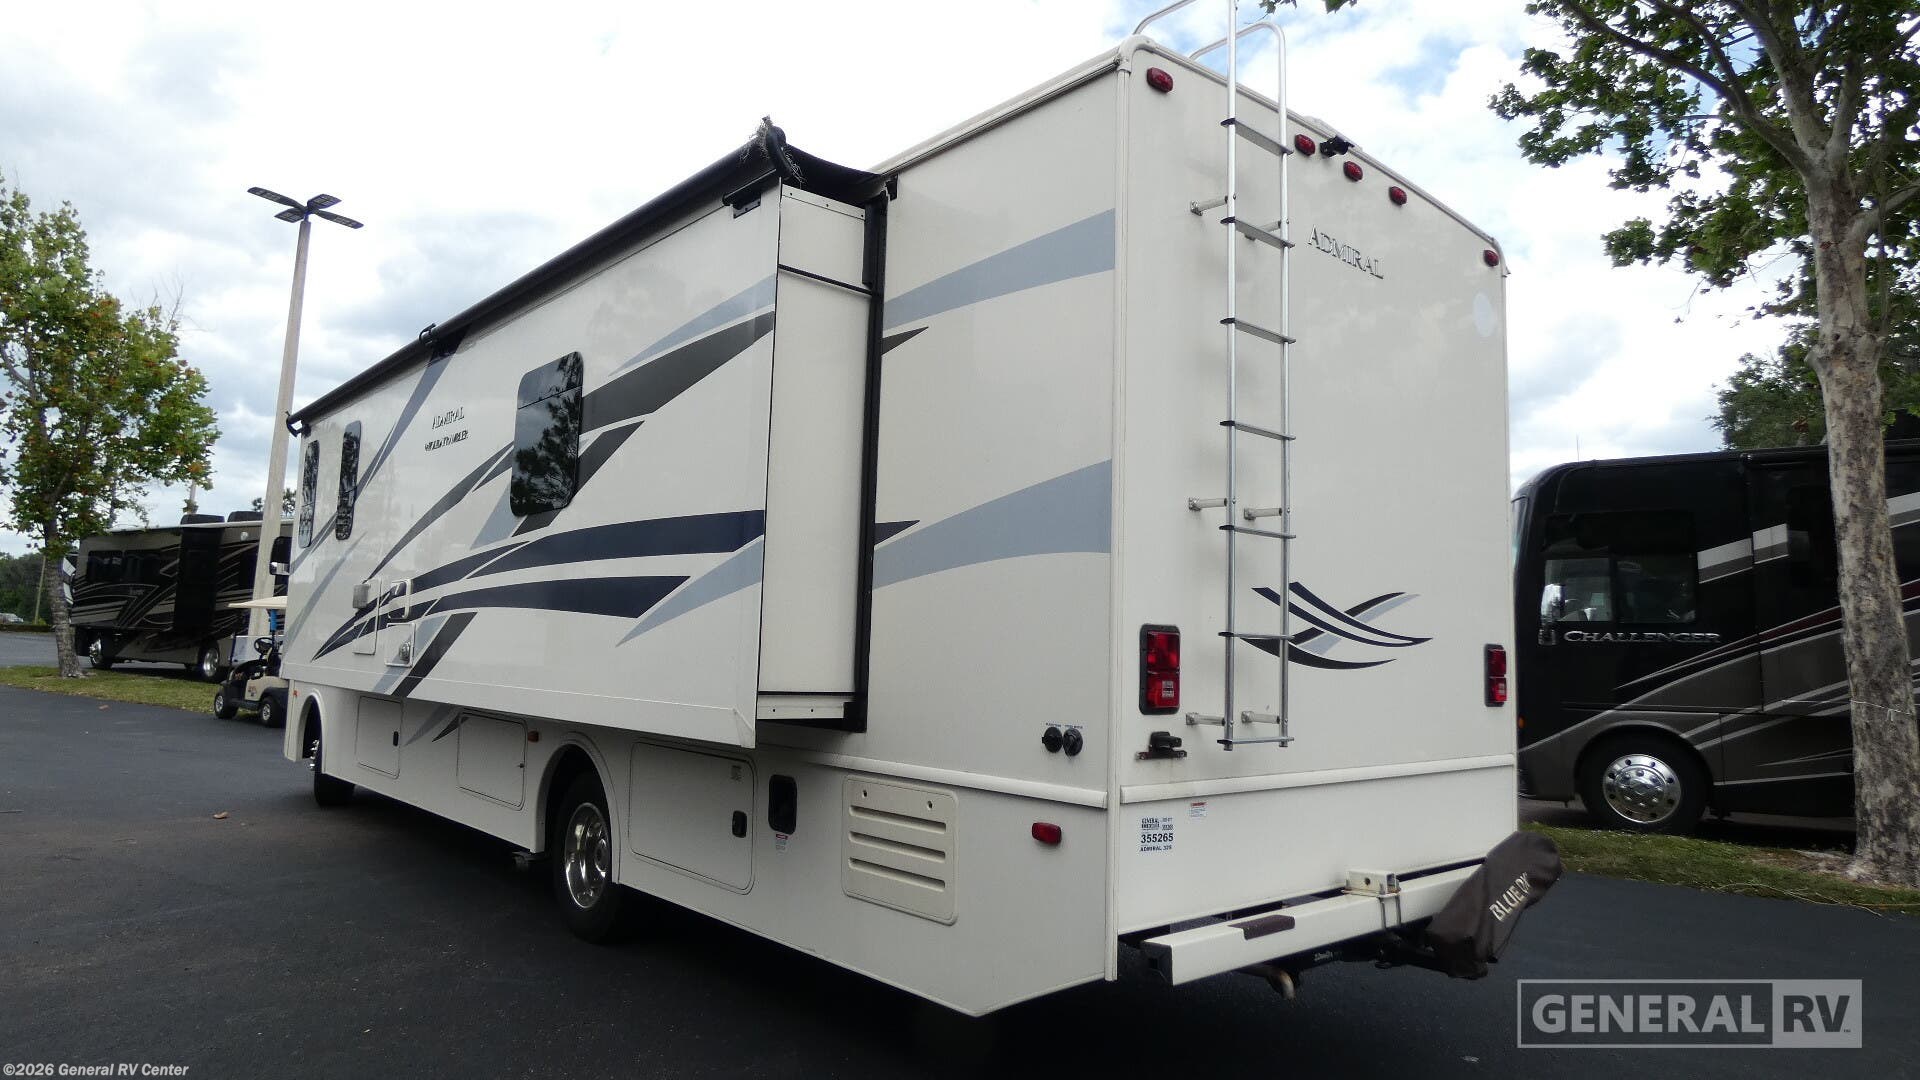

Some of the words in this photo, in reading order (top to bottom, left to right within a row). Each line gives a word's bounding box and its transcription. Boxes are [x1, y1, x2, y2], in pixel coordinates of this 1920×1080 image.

[1307, 224, 1384, 280] ADMIRAL
[1563, 630, 1721, 643] CHALLENGER
[1141, 832, 1174, 844] 355265
[1489, 885, 1526, 921] BLUE
